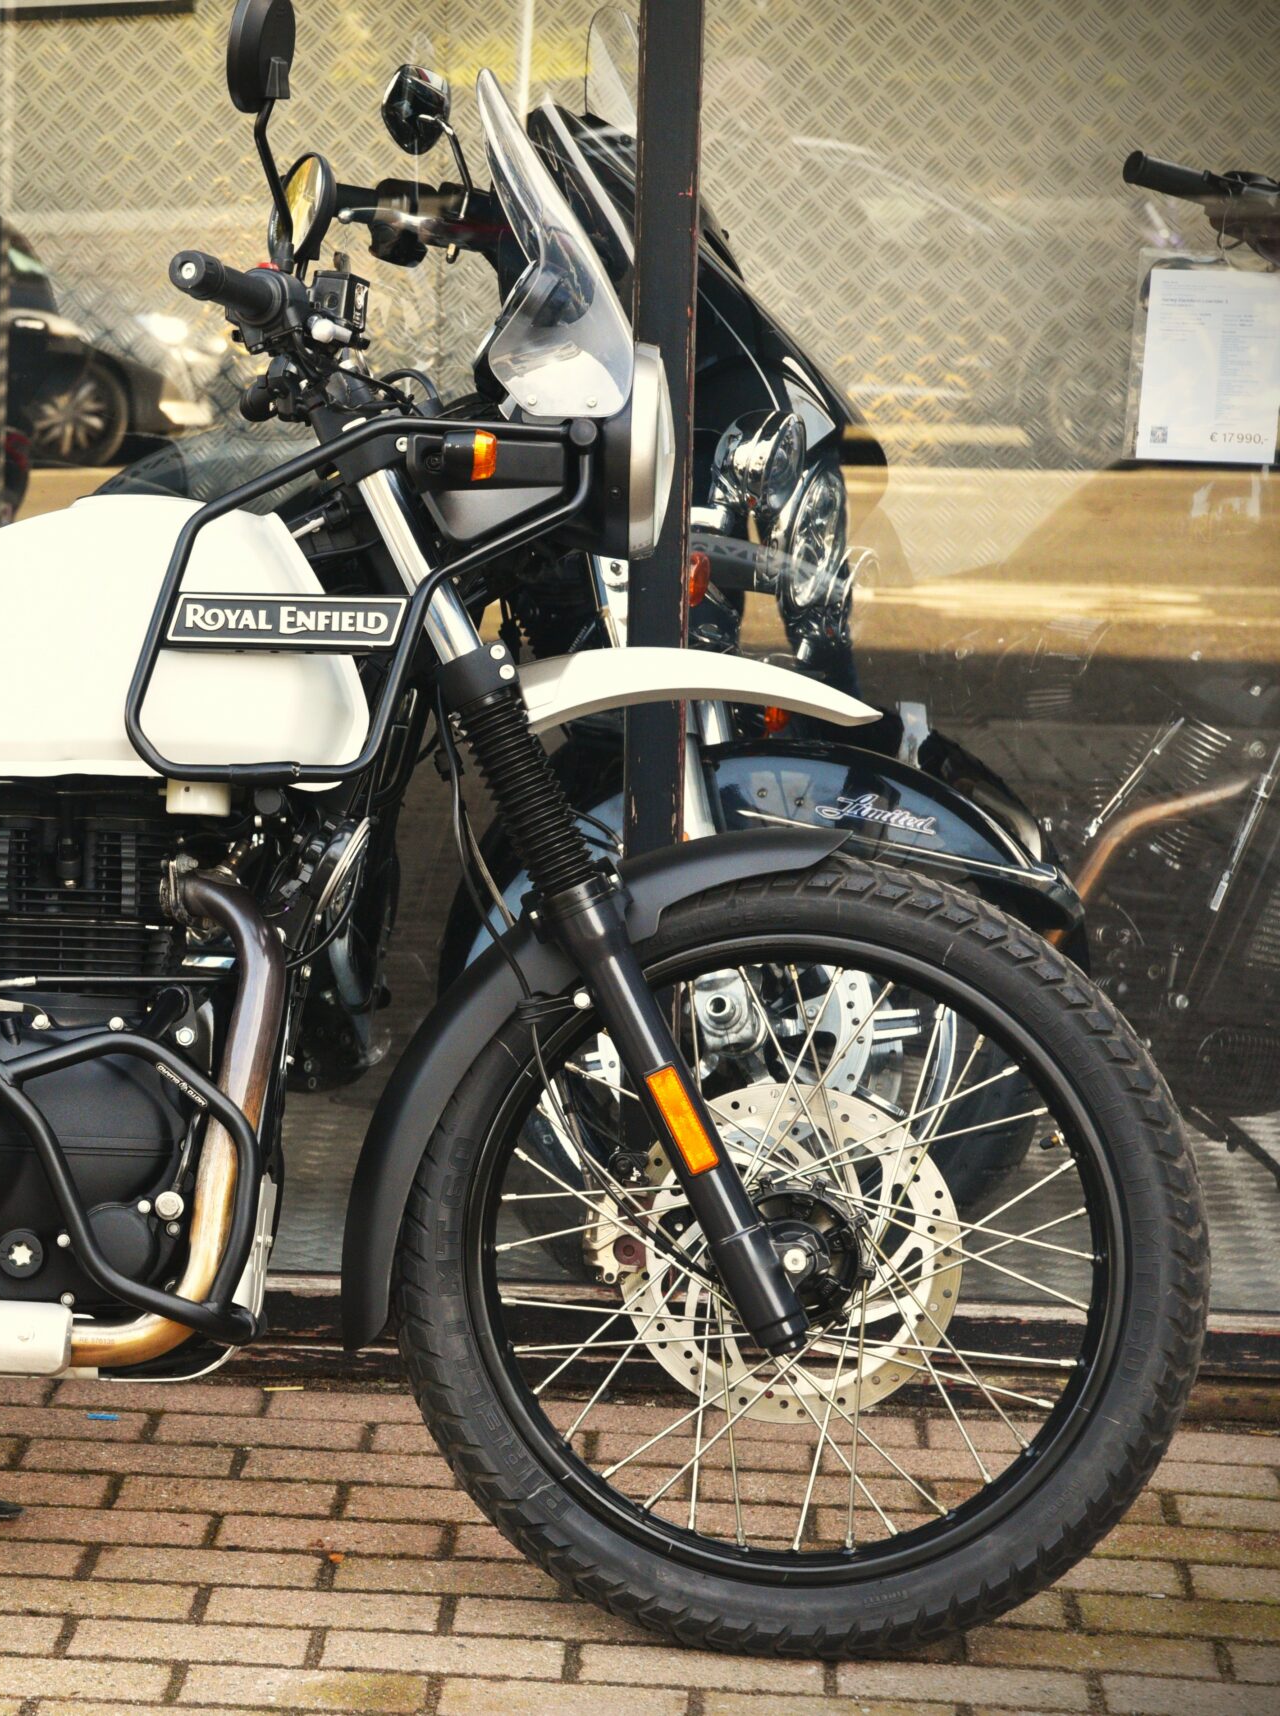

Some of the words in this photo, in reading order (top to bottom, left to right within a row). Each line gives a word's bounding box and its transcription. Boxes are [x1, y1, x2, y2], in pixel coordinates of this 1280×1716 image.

[184, 603, 273, 632] ROYAL
[278, 606, 389, 635] ENFIELD
[815, 793, 937, 836] Limited
[439, 1134, 476, 1211] 60
[436, 1219, 464, 1297] MT
[442, 1321, 576, 1521] PIRELLI
